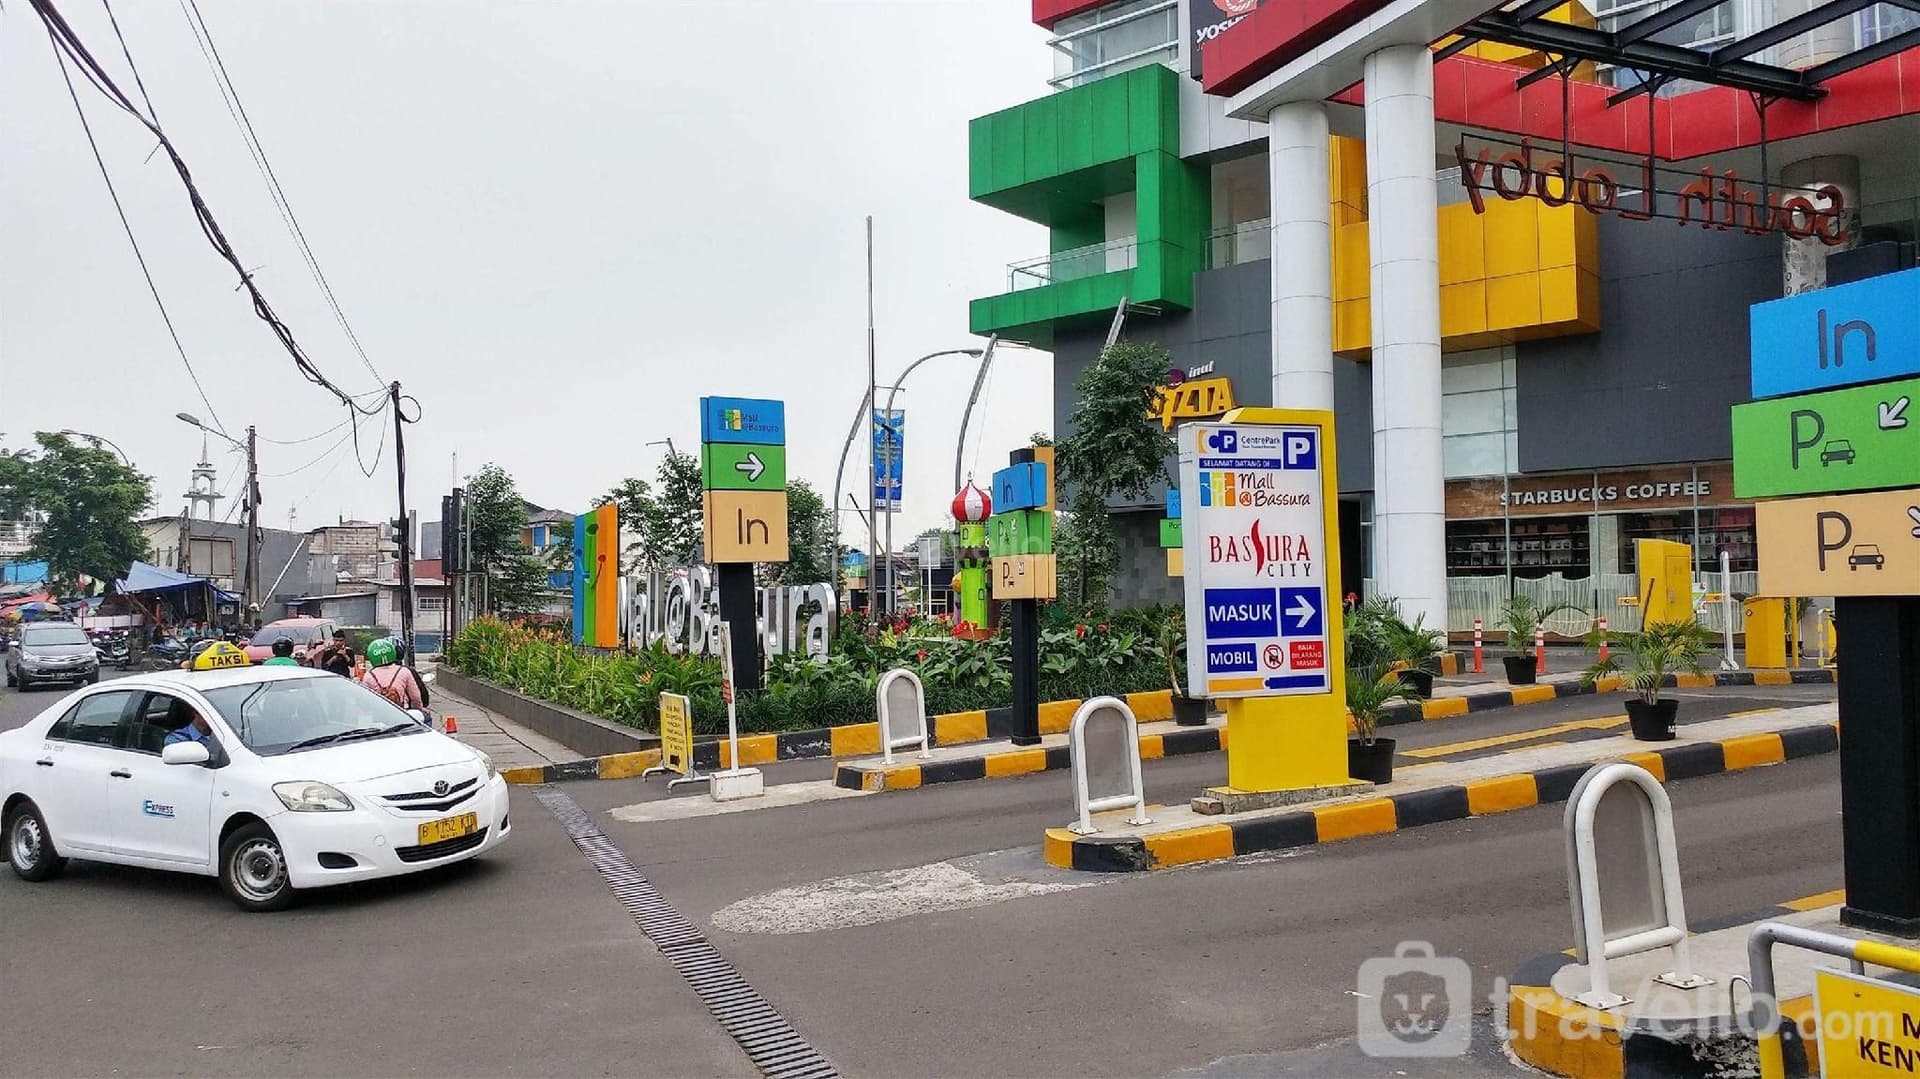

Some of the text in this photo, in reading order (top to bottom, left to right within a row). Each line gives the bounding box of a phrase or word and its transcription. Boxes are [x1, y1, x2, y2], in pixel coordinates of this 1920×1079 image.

[1817, 308, 1876, 370] In
[1240, 435, 1281, 445] CentrePark
[1287, 436, 1311, 465] P
[1790, 409, 1825, 470] P
[1002, 478, 1014, 505] In
[1238, 471, 1275, 489] Mall
[1239, 489, 1311, 507] @Bassura
[1500, 481, 1710, 506] STARBUCKS COFFEE
[738, 508, 769, 545] In
[1209, 518, 1311, 577] BASSURA
[1816, 510, 1853, 572] P
[1267, 563, 1311, 577] CITY
[1209, 604, 1272, 622] MASUK
[209, 654, 245, 667] TAKSI
[1210, 652, 1254, 666] MOBIL
